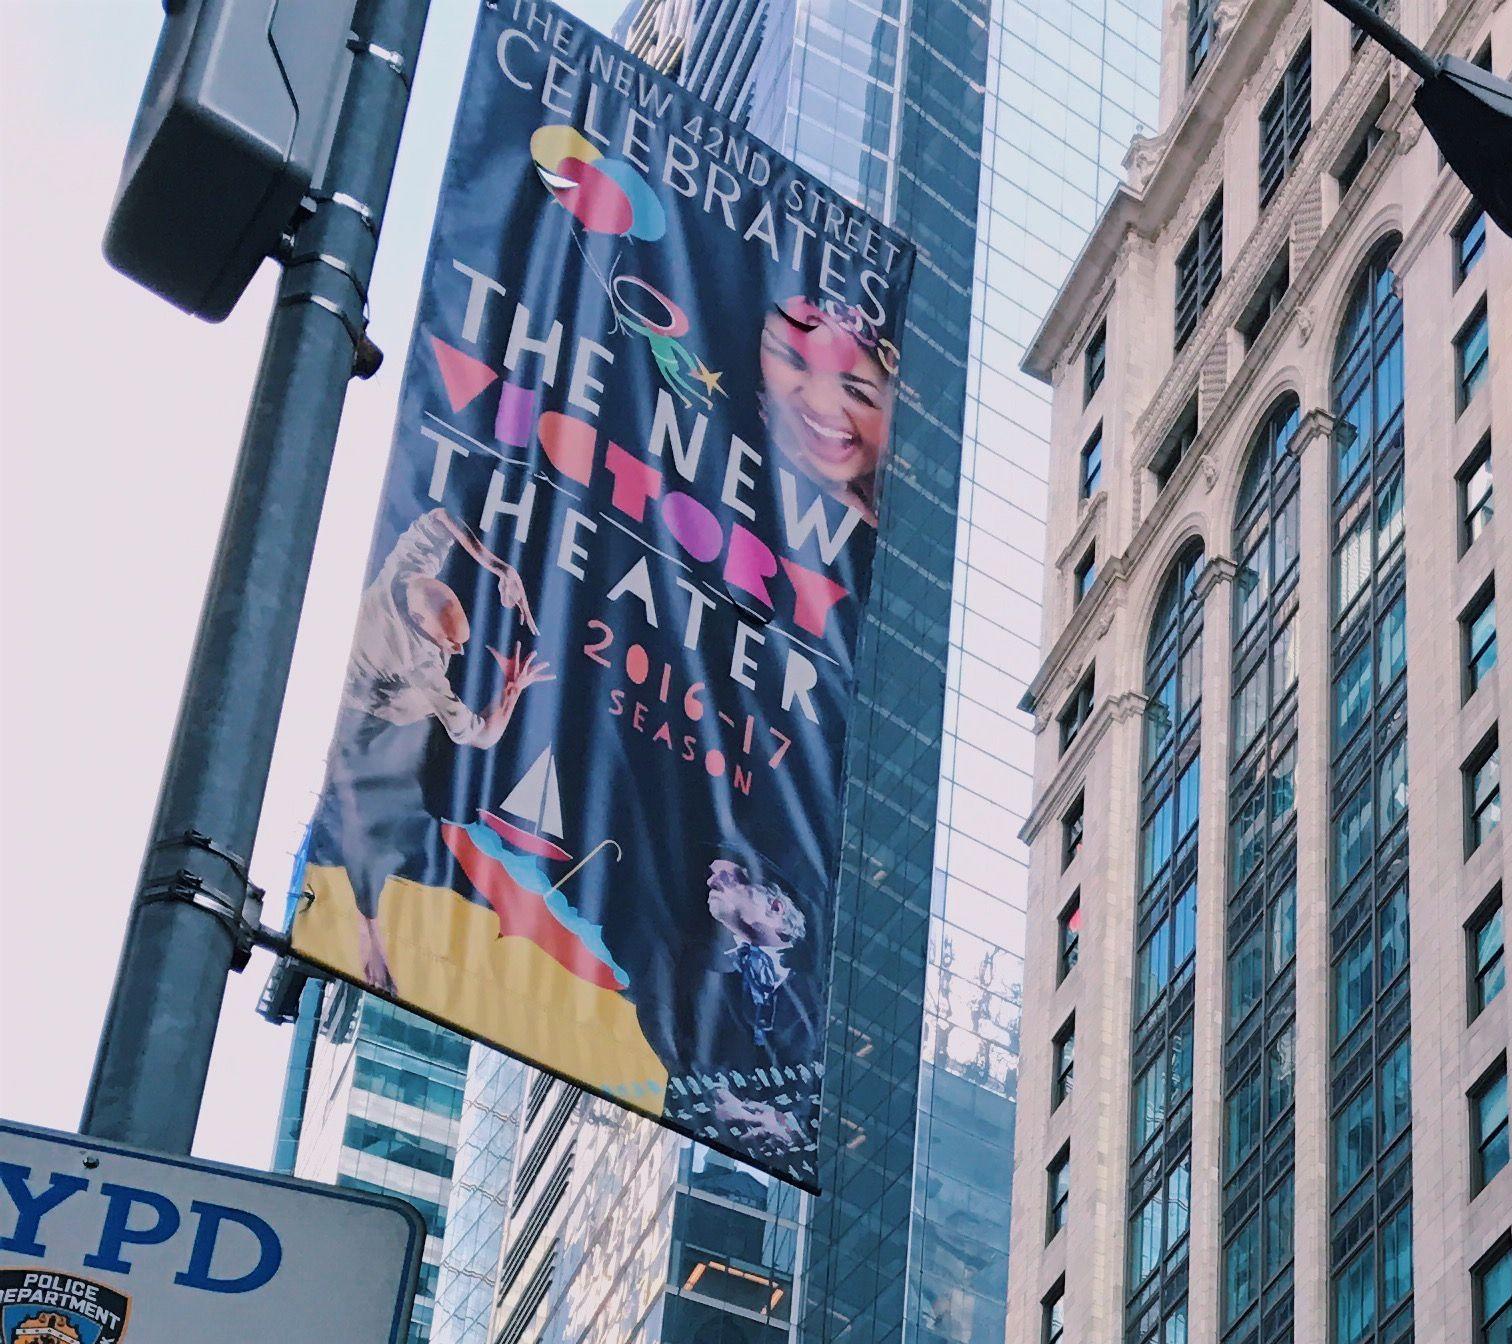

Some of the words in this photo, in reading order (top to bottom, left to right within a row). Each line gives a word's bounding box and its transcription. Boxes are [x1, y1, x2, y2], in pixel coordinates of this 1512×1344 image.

[495, 28, 891, 329] CELEBRATES
[506, 0, 575, 54] THE
[588, 44, 673, 116] NEW
[682, 113, 772, 189] 42ND
[785, 178, 903, 270] STREET
[429, 330, 850, 638] VICTORY
[450, 258, 615, 416] THE
[648, 390, 868, 567] NEW
[420, 425, 821, 726] THEATER
[582, 618, 792, 769] 2016-17
[607, 688, 754, 796] SEASON
[24, 1273, 99, 1302] POLICE
